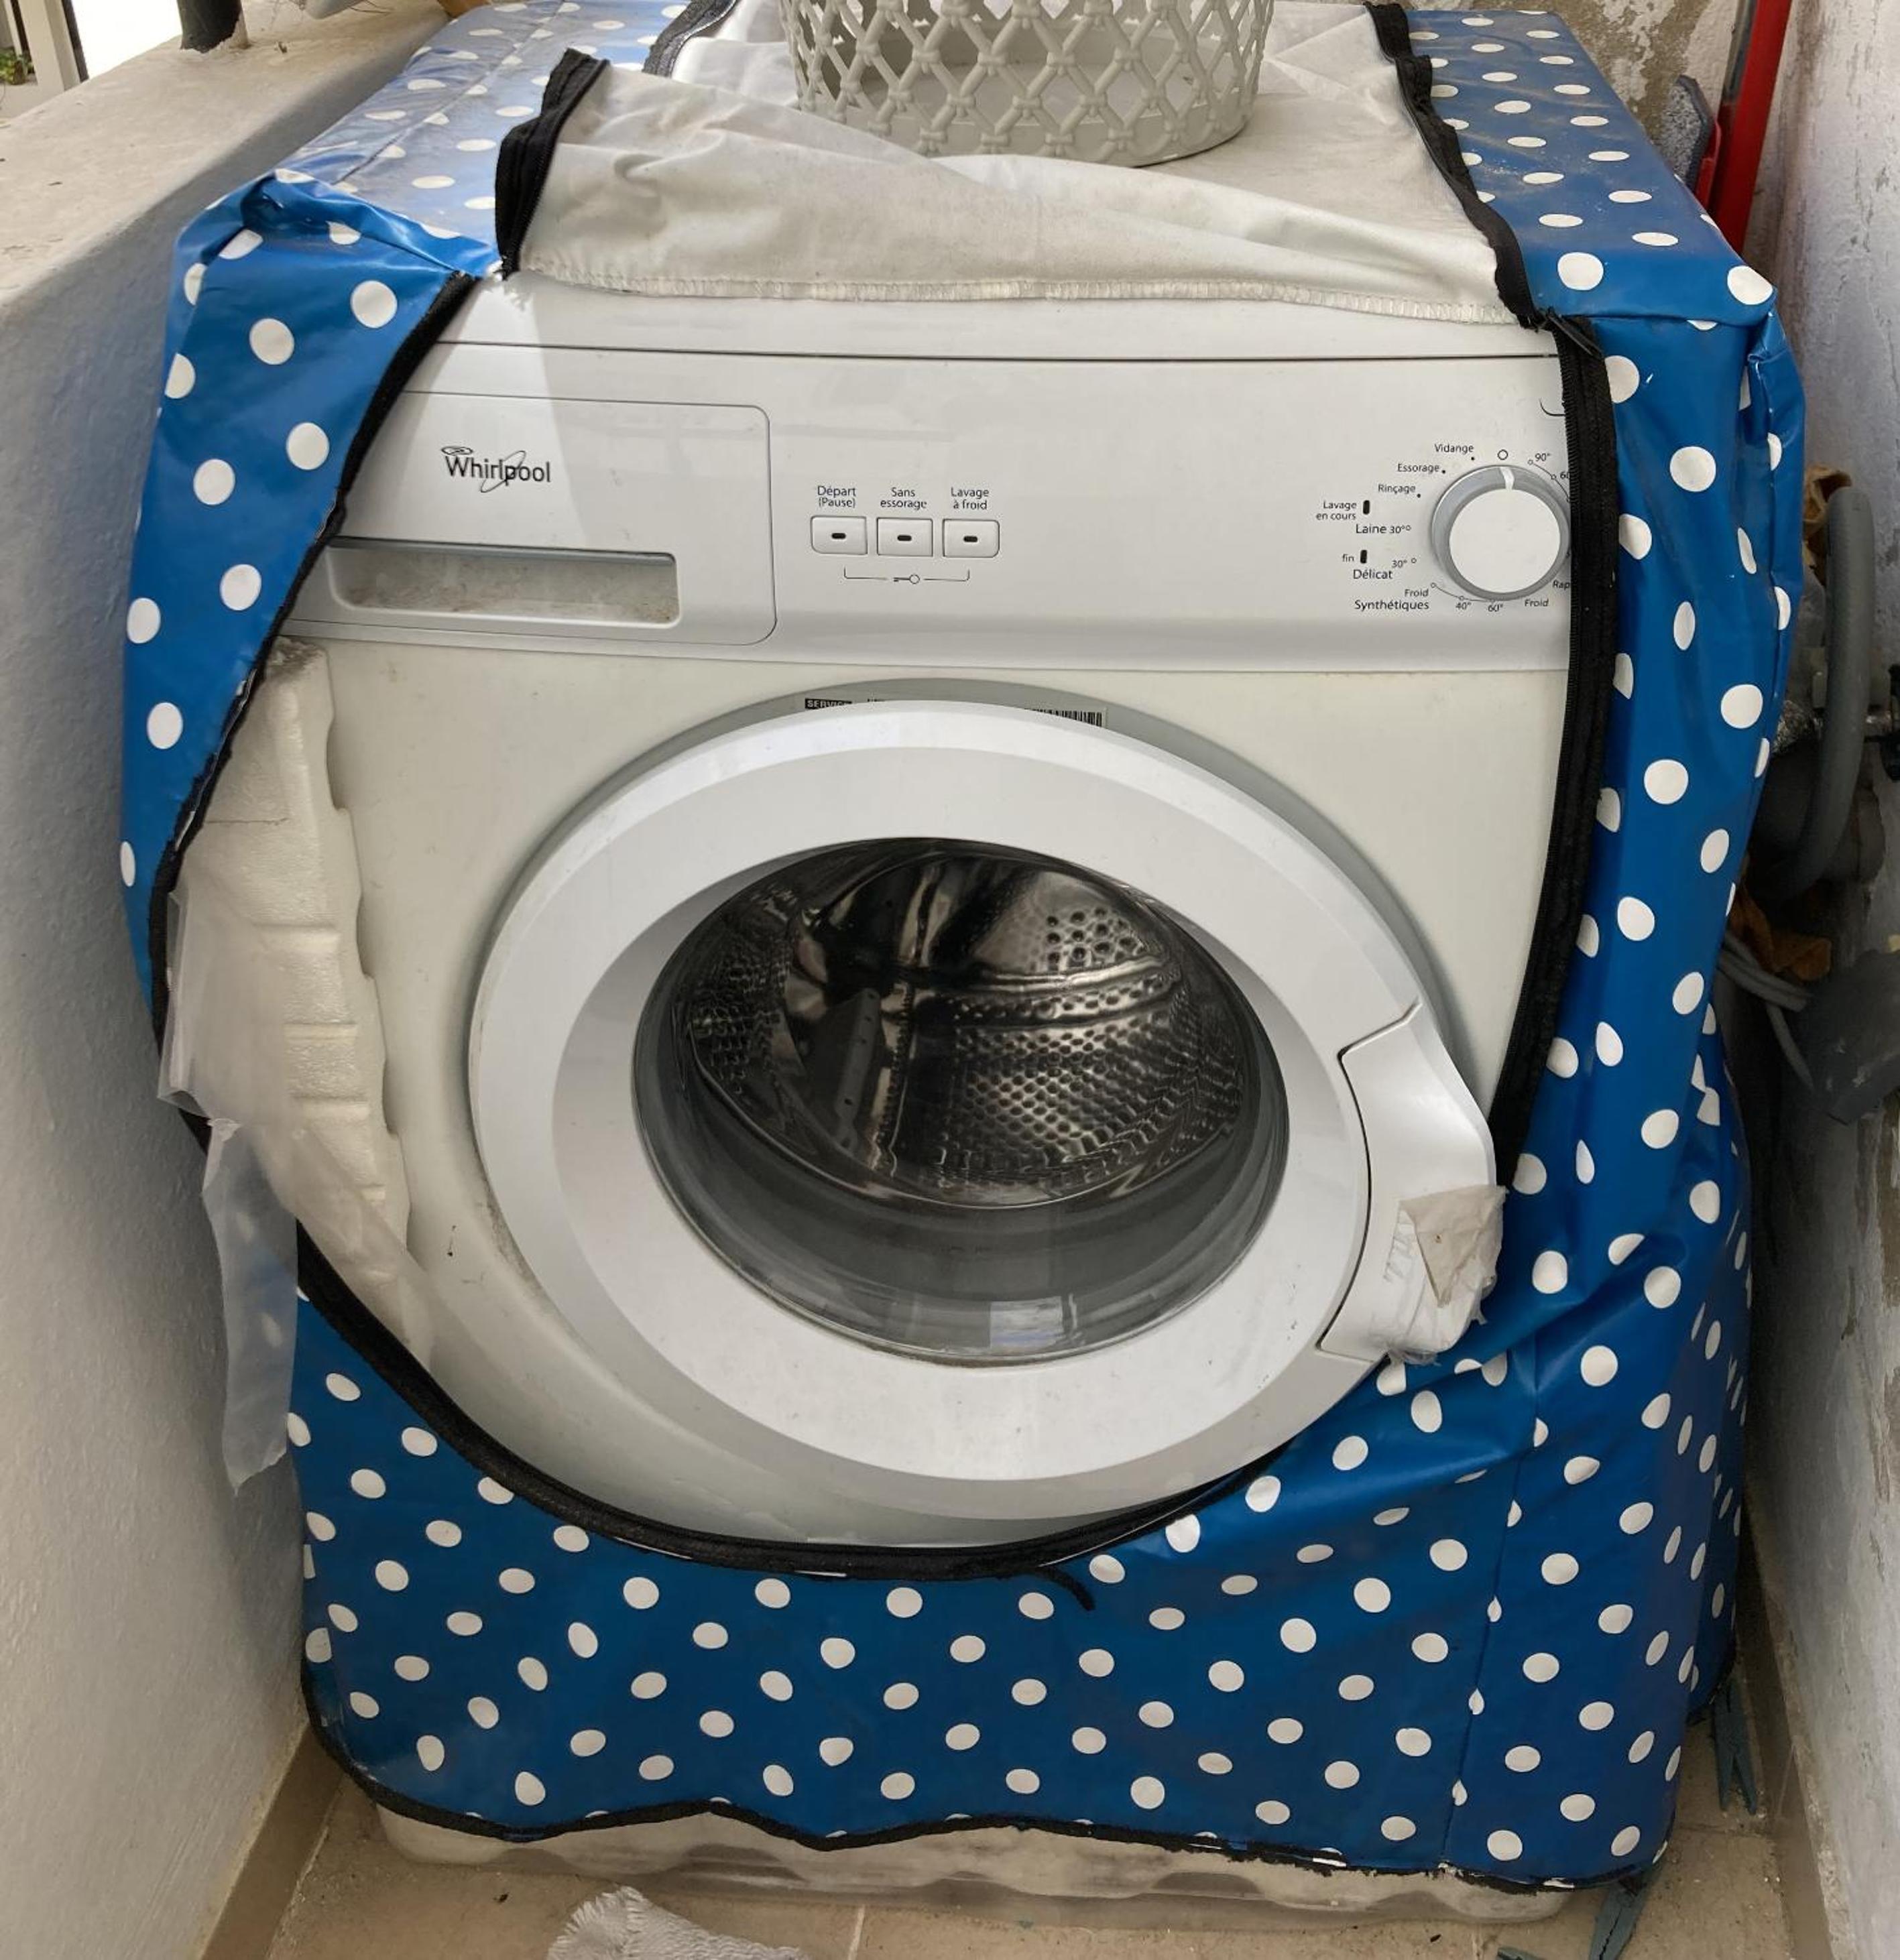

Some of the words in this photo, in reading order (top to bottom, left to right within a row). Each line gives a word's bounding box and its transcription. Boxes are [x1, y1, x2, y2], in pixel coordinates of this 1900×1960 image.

[1434, 444, 1474, 454] Vidange
[444, 455, 551, 487] Whirlpool
[1397, 463, 1440, 474] Essorage
[817, 485, 857, 498] Départ
[891, 487, 916, 497] Sans
[951, 487, 990, 499] Lavage
[1378, 484, 1416, 494] Rinçage
[818, 497, 855, 508] (Pause)
[880, 499, 927, 510] essorage
[953, 499, 959, 510] à
[962, 499, 988, 510] froid
[1323, 501, 1358, 511] Lavage
[1330, 512, 1356, 521] cours
[1356, 523, 1387, 534] Laine
[1342, 553, 1355, 562] fin
[1353, 568, 1394, 580] Délicat
[1405, 588, 1429, 597] Froid
[1354, 599, 1430, 612] Synthétiques
[1524, 598, 1549, 607] Froid
